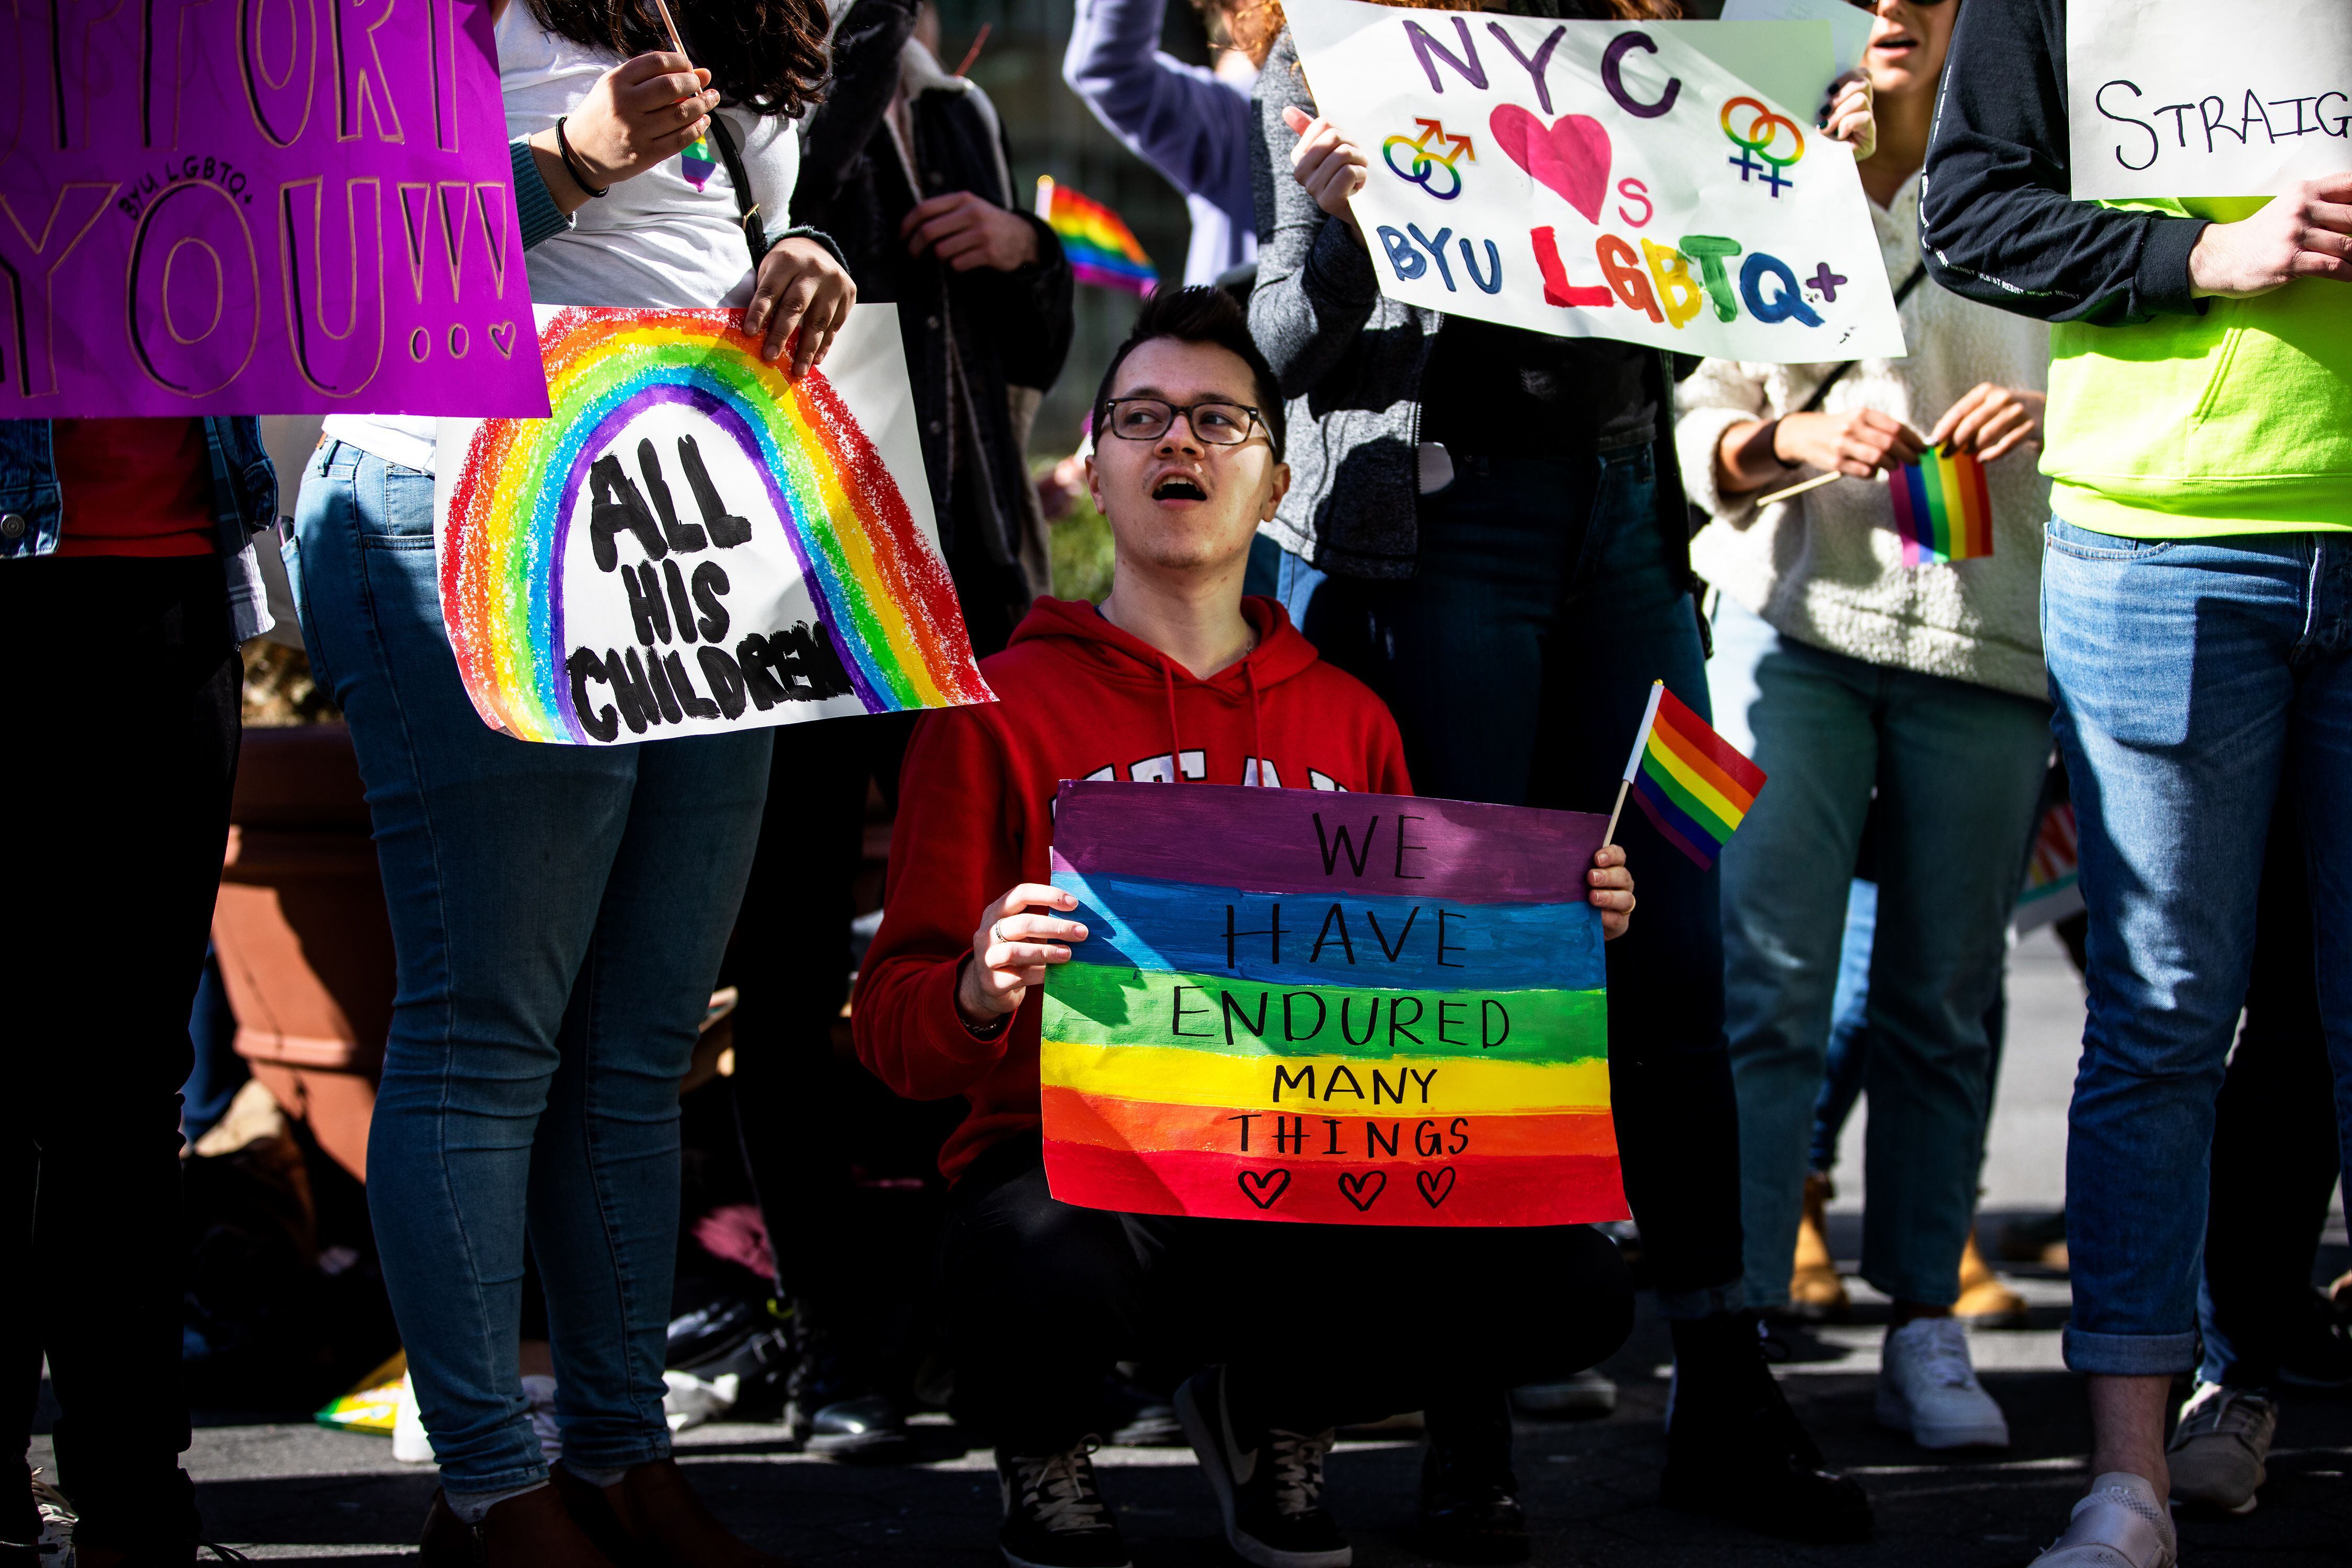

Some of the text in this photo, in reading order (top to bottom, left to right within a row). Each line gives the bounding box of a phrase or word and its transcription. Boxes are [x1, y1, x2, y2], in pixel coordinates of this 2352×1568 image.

[1402, 16, 1681, 118] NYC
[2095, 79, 2352, 170] STRAIG
[118, 172, 160, 221] BYU
[1376, 222, 1848, 329] BYU LGBTQ+
[1978, 271, 2001, 286] RESIST
[2002, 280, 2024, 295] RESIST
[589, 434, 752, 573] ALL
[621, 558, 730, 647] HIS
[565, 619, 856, 744] CHILDREN
[1311, 812, 1427, 880] WE
[1220, 902, 1467, 970] HAVE
[1172, 985, 1511, 1048] ENDURED
[1272, 1064, 1438, 1105] MANY
[1227, 1113, 1470, 1159] THINGS
